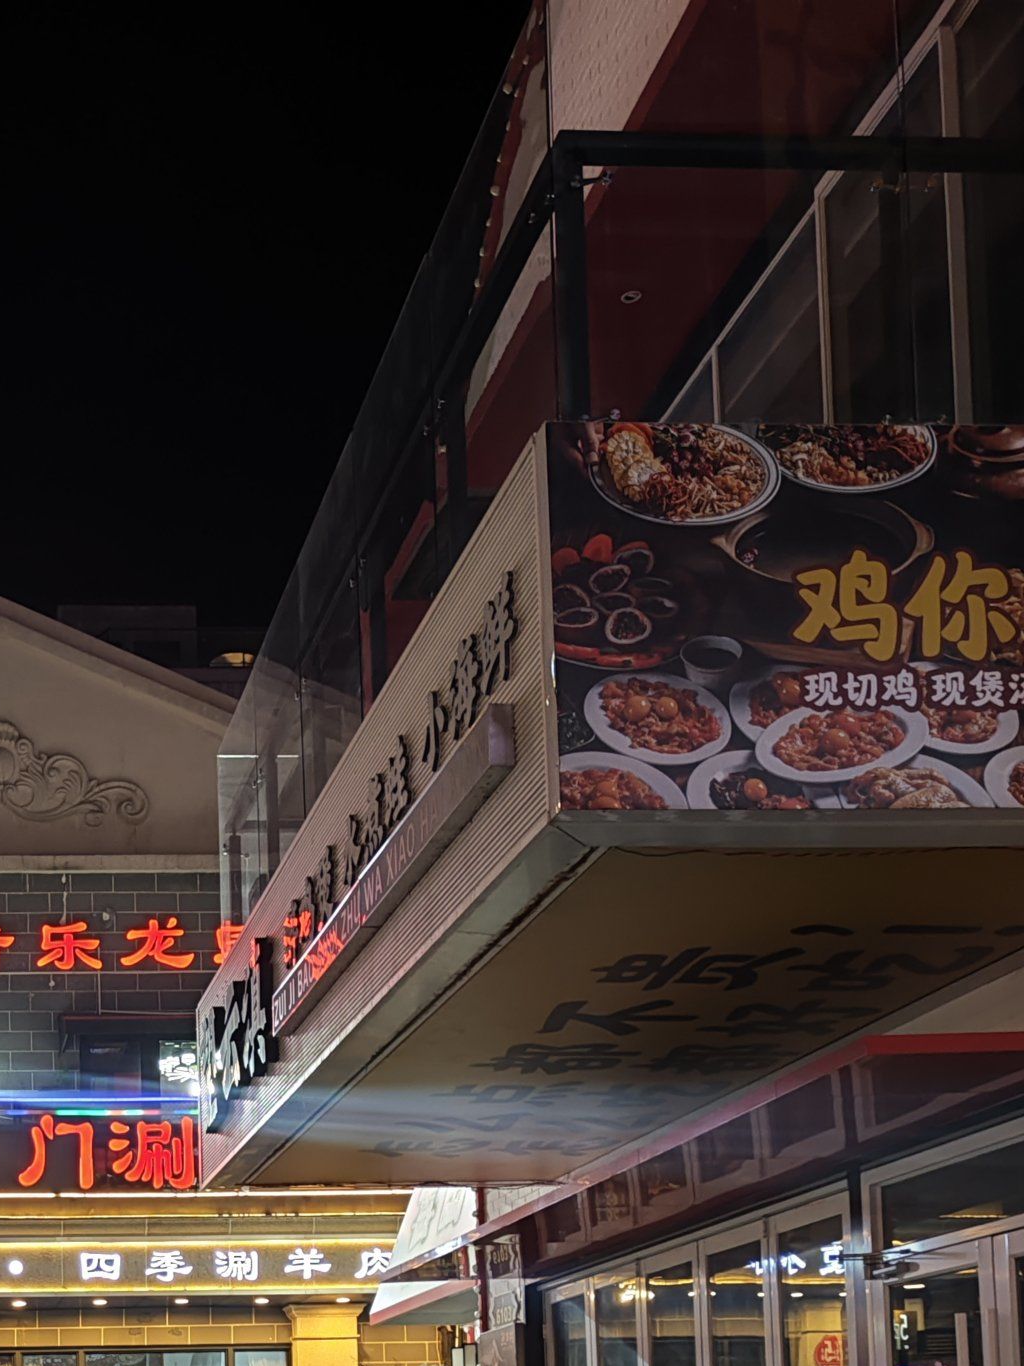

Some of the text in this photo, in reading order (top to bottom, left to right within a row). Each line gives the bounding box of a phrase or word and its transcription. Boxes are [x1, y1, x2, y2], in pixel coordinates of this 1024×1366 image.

[793, 550, 1016, 661] 鸡你
[422, 570, 519, 773] 小海鲜
[804, 669, 918, 708] 现切鸡
[274, 987, 288, 1028] ZUI
[340, 886, 361, 940] ZHU
[363, 866, 384, 912] WA
[385, 825, 415, 887] XIAO
[80, 1248, 392, 1283] 四季涮羊肉
